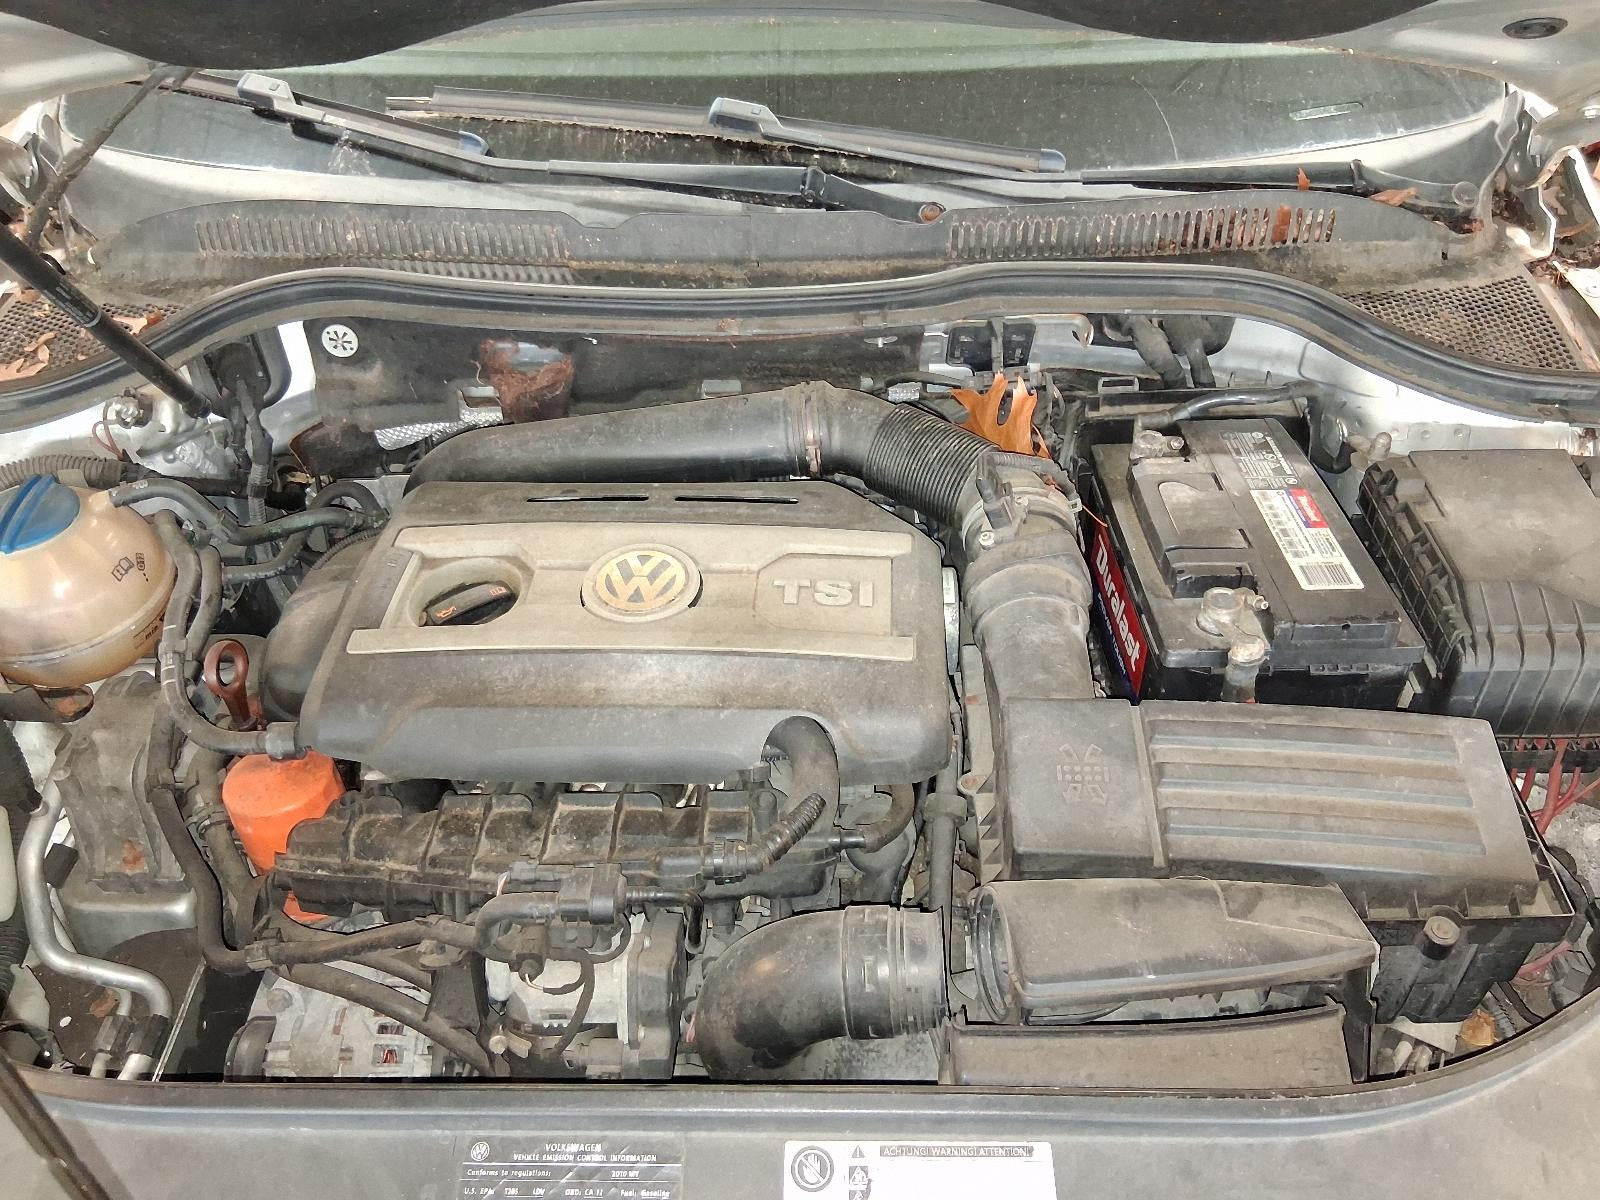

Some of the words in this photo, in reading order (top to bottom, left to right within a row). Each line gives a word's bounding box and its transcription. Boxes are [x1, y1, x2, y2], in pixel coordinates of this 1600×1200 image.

[773, 578, 875, 607] TSI
[1095, 534, 1141, 672] Duralast
[545, 1143, 602, 1152] VOLKSWAGEN
[513, 1153, 540, 1161] VEHICLE
[542, 1154, 575, 1162] EMISSION
[577, 1154, 608, 1162] CONTROL
[610, 1154, 657, 1162] INFORMATION
[467, 1168, 499, 1176] Conforms
[611, 1170, 628, 1178] 2010
